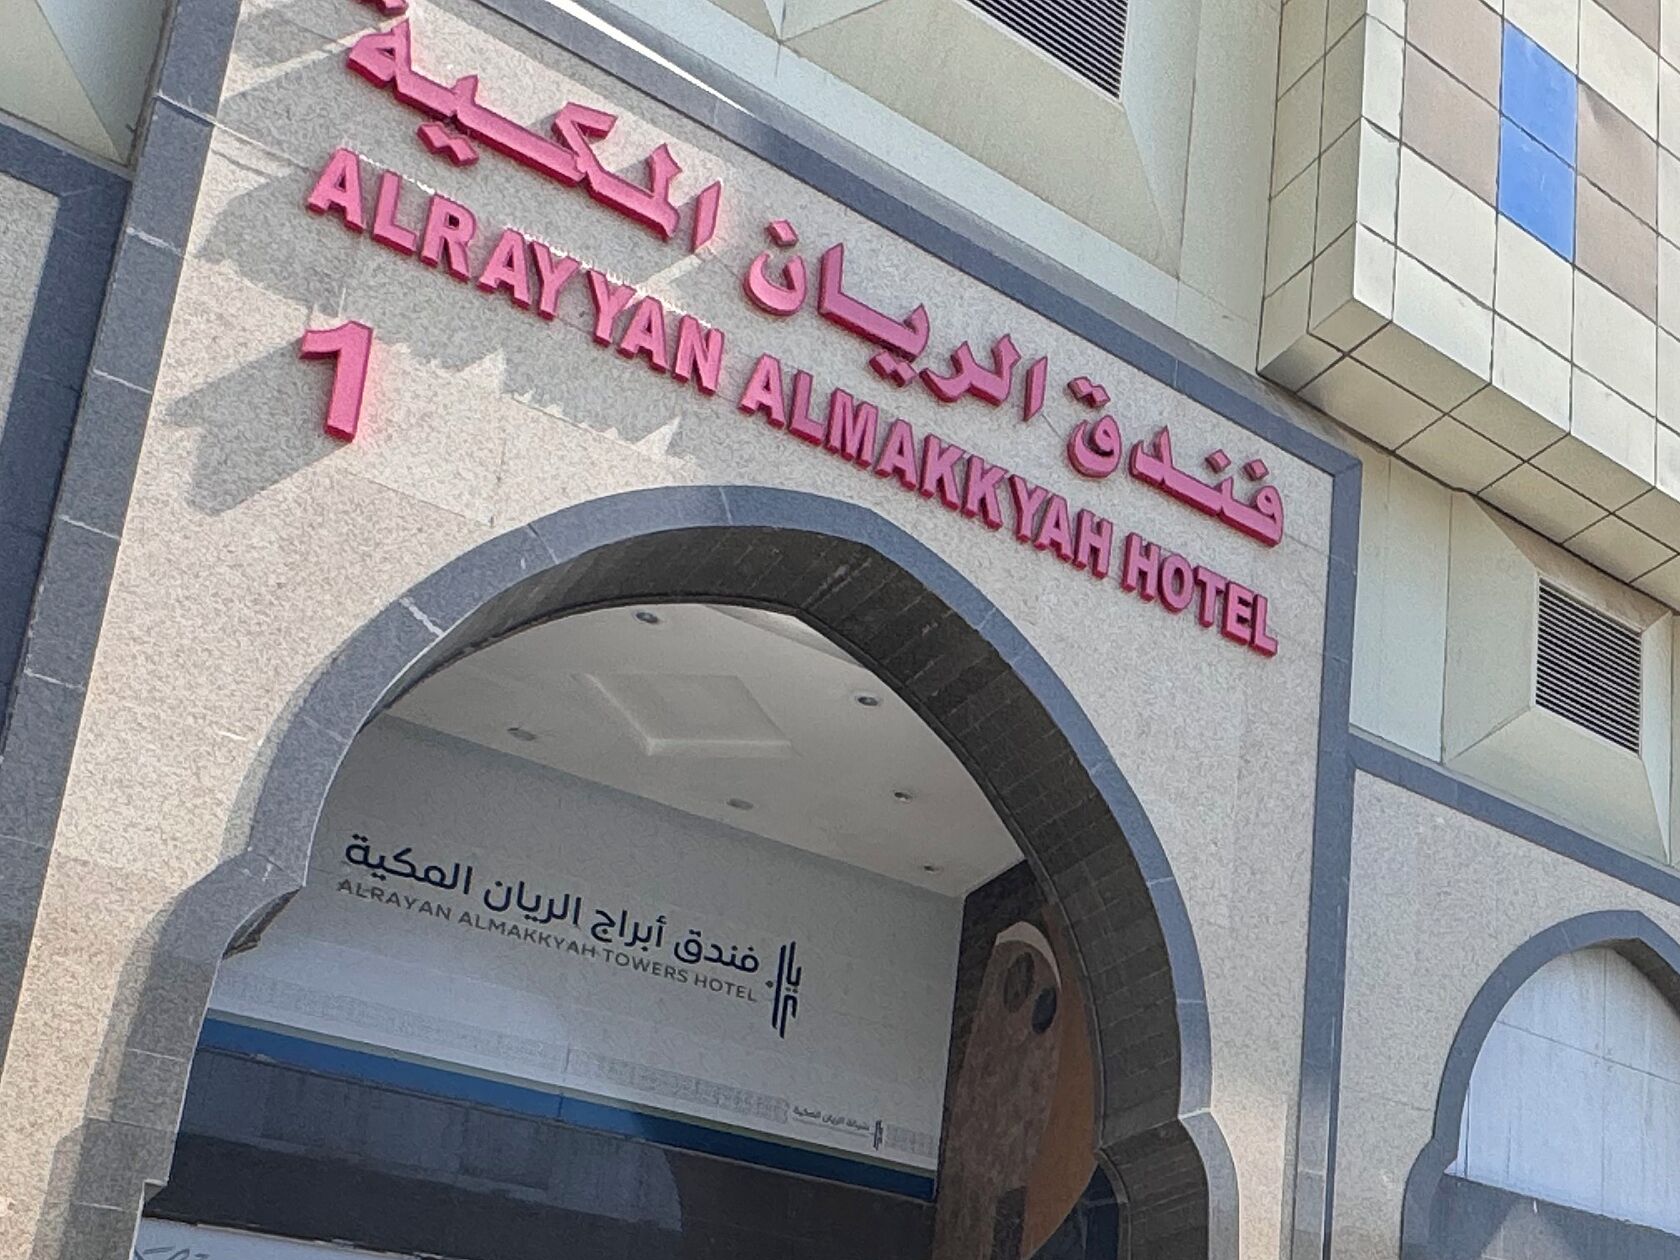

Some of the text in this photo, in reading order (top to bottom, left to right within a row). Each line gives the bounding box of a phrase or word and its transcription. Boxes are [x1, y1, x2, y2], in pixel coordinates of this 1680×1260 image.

[347, 0, 1286, 547] فندق الريان المكية
[299, 320, 376, 442] 1
[305, 145, 1279, 657] ALRAYYAN ALMAKKYAH HOTEL
[335, 877, 759, 1003] ALRAYAN ALMAKKYAH TOWERS HOTEL
[344, 832, 761, 977] فندق أبراج الريان المكية
